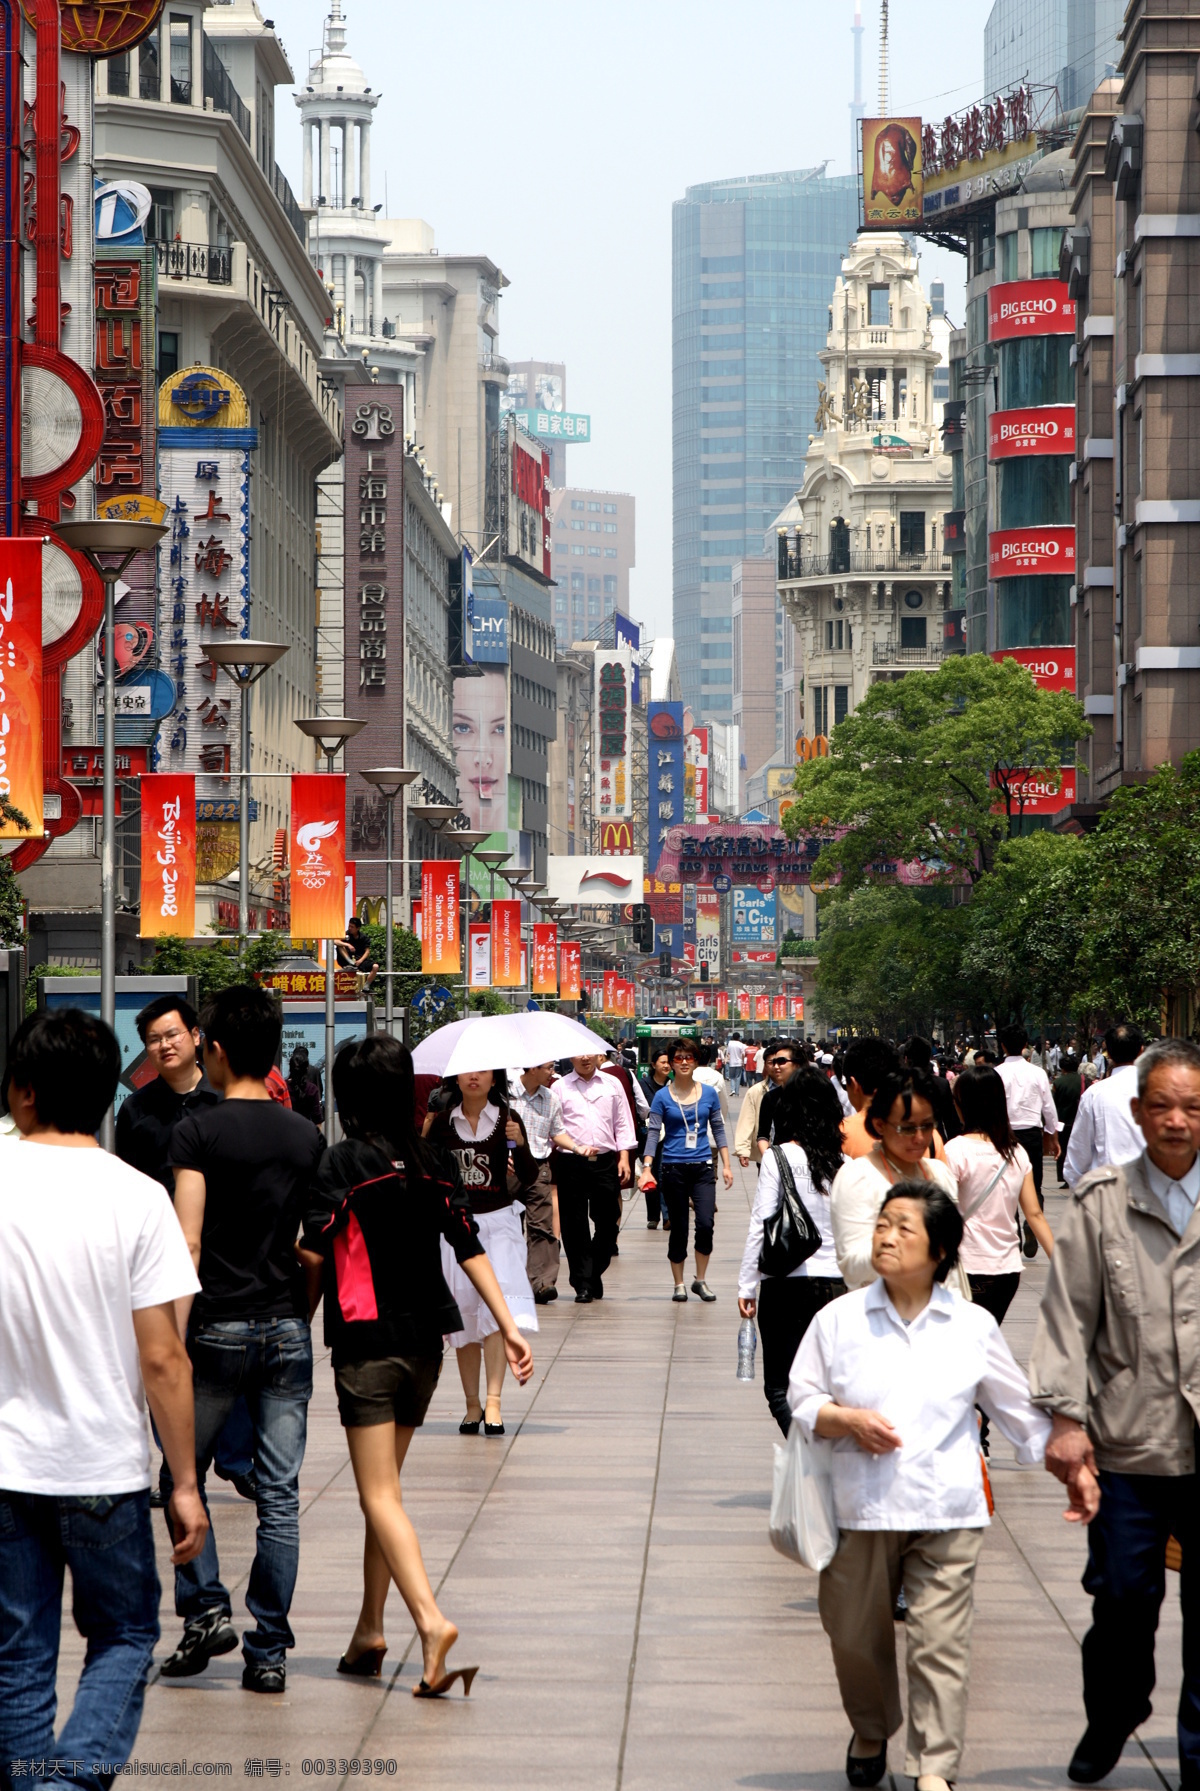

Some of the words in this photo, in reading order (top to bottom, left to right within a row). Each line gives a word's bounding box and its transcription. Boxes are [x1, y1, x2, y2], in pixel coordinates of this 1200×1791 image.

[868, 208, 920, 219] 燕云楼
[1001, 303, 1018, 319] BIG
[1020, 298, 1057, 313] ECHO
[537, 413, 587, 437] 国家电网
[1001, 424, 1019, 440] BIG
[1021, 421, 1058, 436] ECHO
[1002, 543, 1020, 559] BIG
[1022, 541, 1059, 556] ECHO
[359, 450, 388, 687] 上海市第一食品商店
[157, 795, 181, 865] Beijing
[679, 862, 702, 872] BAO
[708, 863, 723, 872] DA
[731, 862, 769, 873] XIANG
[161, 868, 178, 917] 2008
[446, 874, 455, 895] Light
[435, 894, 444, 917] Share
[447, 896, 455, 910] the
[733, 889, 766, 908] Pearls
[435, 918, 443, 932] the
[447, 911, 455, 941] Passion
[503, 909, 511, 937] Journey
[748, 908, 775, 925] City
[435, 933, 443, 961] Dream
[504, 937, 511, 946] of
[503, 946, 511, 978] harmony
[698, 948, 719, 963] City
[756, 952, 771, 962] KFC
